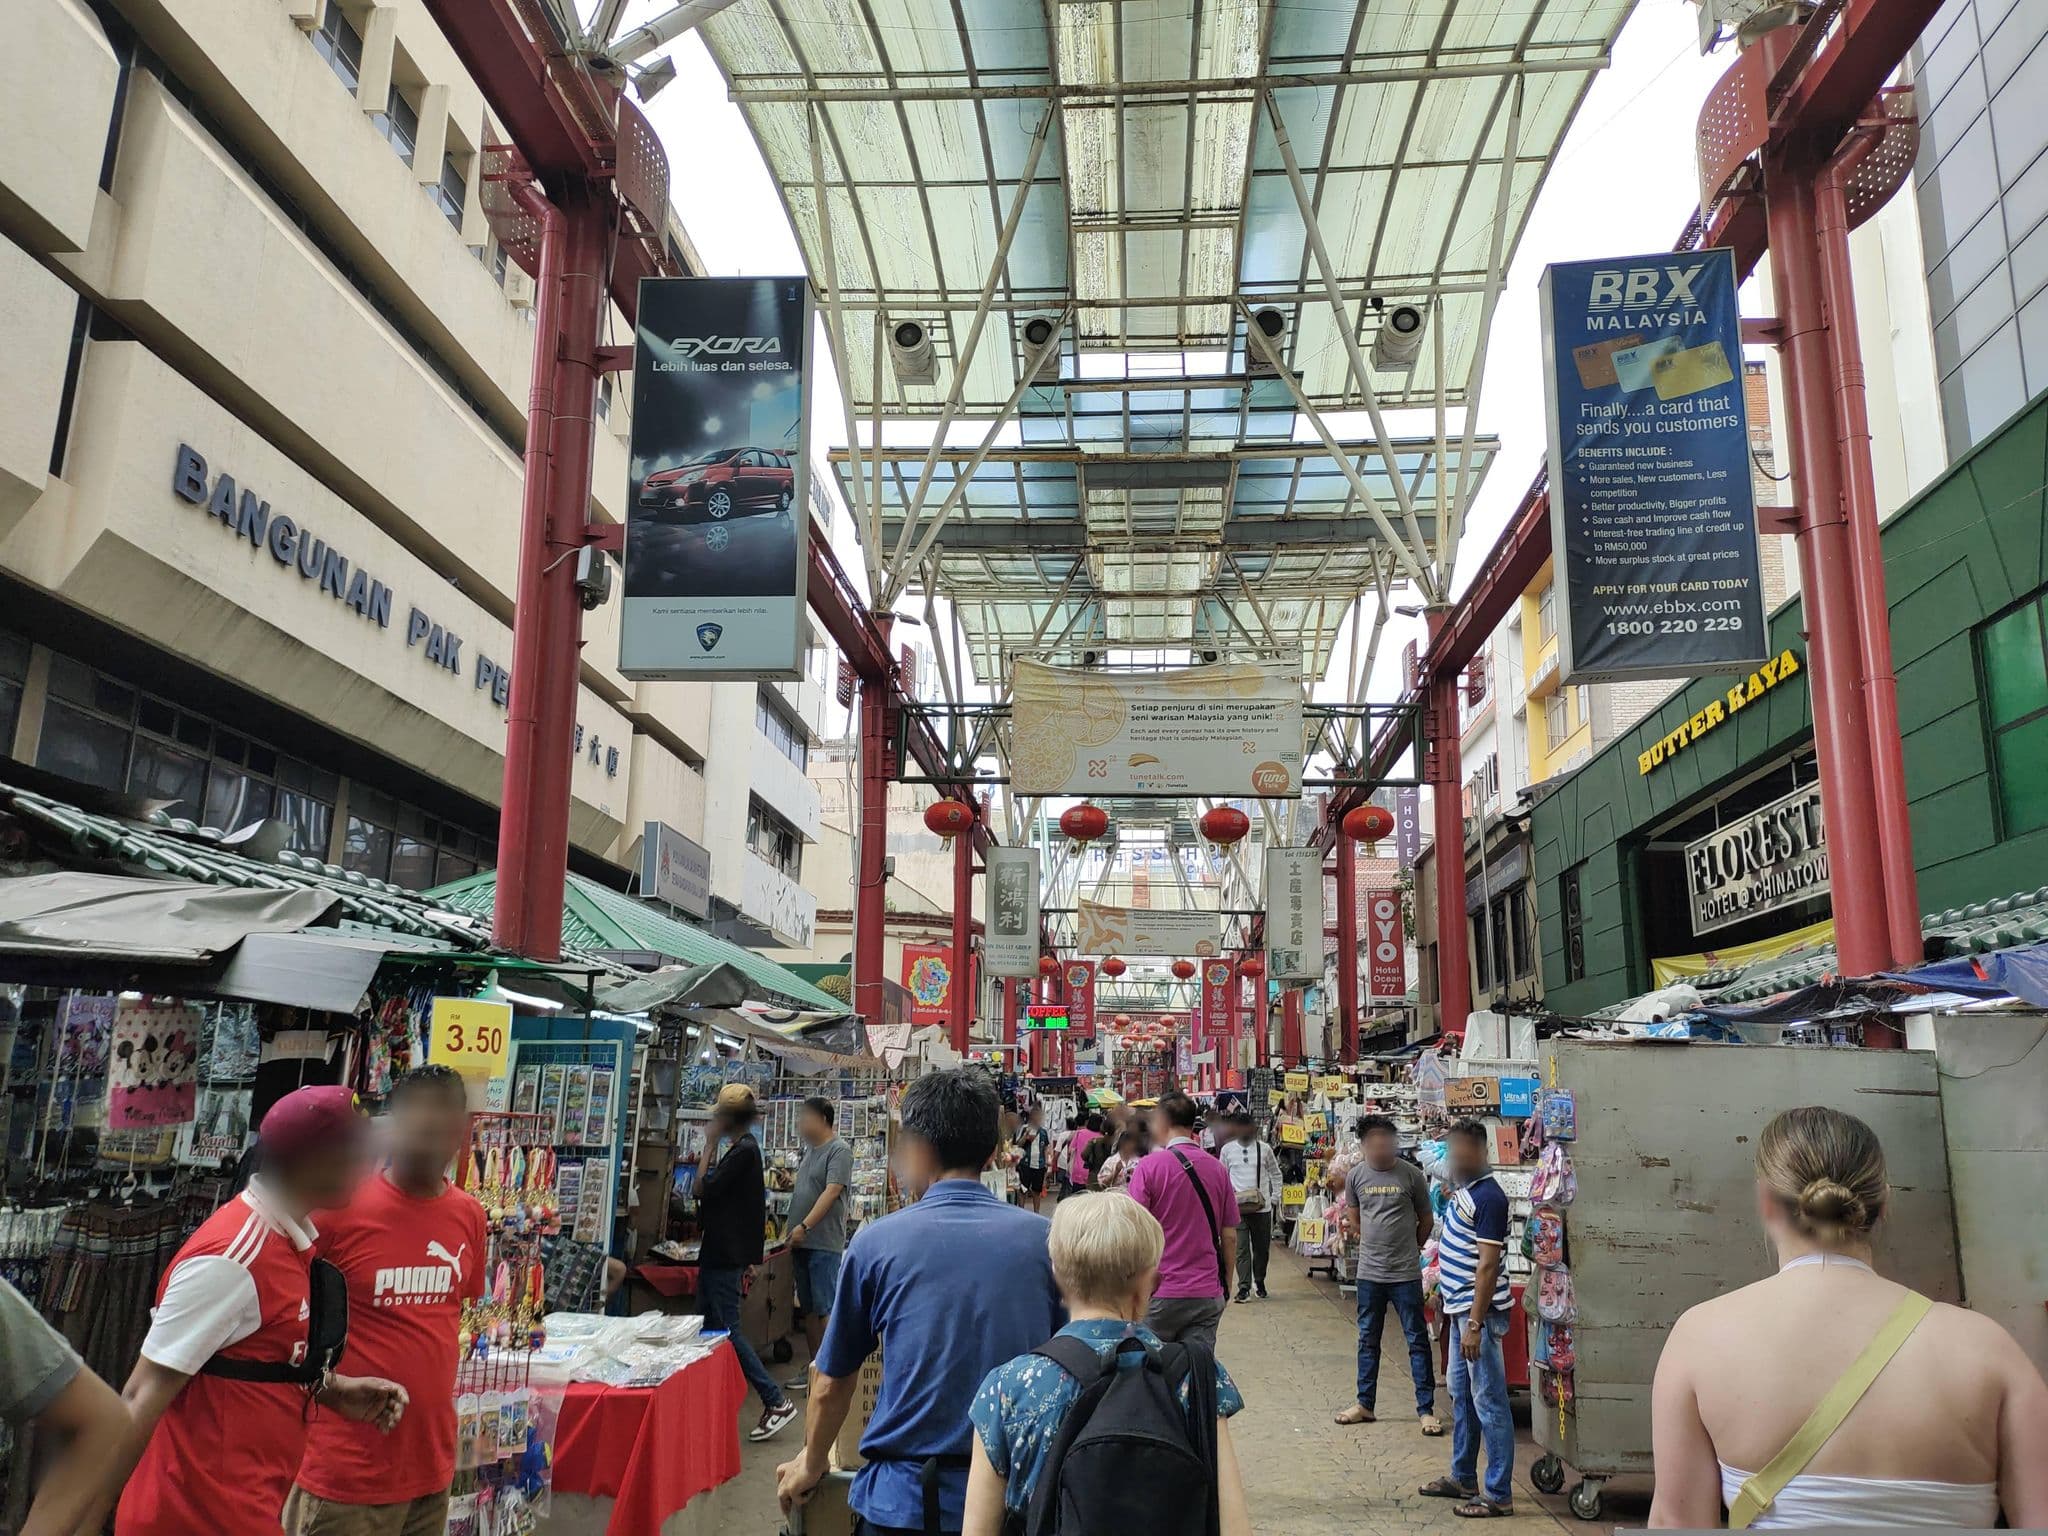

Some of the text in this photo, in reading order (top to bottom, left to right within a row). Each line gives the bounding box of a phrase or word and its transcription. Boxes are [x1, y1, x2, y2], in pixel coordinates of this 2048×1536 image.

[1587, 263, 1704, 313] BBX
[1586, 310, 1708, 331] MALAYSIA
[668, 335, 782, 358] EXORA
[652, 360, 793, 372] Lebih luas dan selesa.
[1659, 398, 1694, 416] card
[1697, 395, 1731, 411] that
[1576, 414, 1738, 437] sends you customers
[1578, 448, 1623, 458] BENEFITS
[1625, 447, 1666, 457] INCLUDE
[1588, 459, 1694, 471] Guaranteed new business
[1589, 470, 1727, 485] More sales, New customers, Less
[1590, 489, 1638, 499] competition
[1591, 496, 1727, 512] Better productivity, Bigger profits
[1592, 515, 1613, 524] Save
[1614, 515, 1634, 524] cash
[1635, 514, 1652, 523] and
[1689, 511, 1710, 520] cash
[1712, 509, 1732, 519] flow
[1593, 522, 1745, 538] Interest-free trading line of credit up
[1594, 541, 1648, 552] to RM50,000
[1595, 549, 1740, 566] Move surplus stock at great prices
[174, 443, 509, 707] BANGUNAN PAK PE
[1592, 578, 1749, 595] APPLY FOR YOUR CARD TODAY
[1603, 599, 1741, 616] www.ebbx.com
[1606, 616, 1743, 635] 1800 220 229
[1131, 703, 1276, 713] Setiap penjuru di sini merupakan
[1637, 648, 1799, 776] BUTTER KAYA
[1187, 713, 1225, 722] Malaysia
[1227, 714, 1249, 722] yang
[1251, 712, 1273, 721] unik!
[1255, 769, 1287, 787] Tune
[1700, 853, 1830, 922] HOTEL @ CHINATOW
[1374, 899, 1397, 963] OYO
[1375, 966, 1400, 974] Hotel
[1373, 974, 1402, 983] Ocean
[1381, 984, 1396, 993] 77
[446, 1023, 502, 1054] 3.50
[1312, 1116, 1322, 1128] 4
[1287, 1190, 1303, 1199] 9.00
[374, 1266, 454, 1296] PUMA
[863, 1384, 880, 1396] N.W
